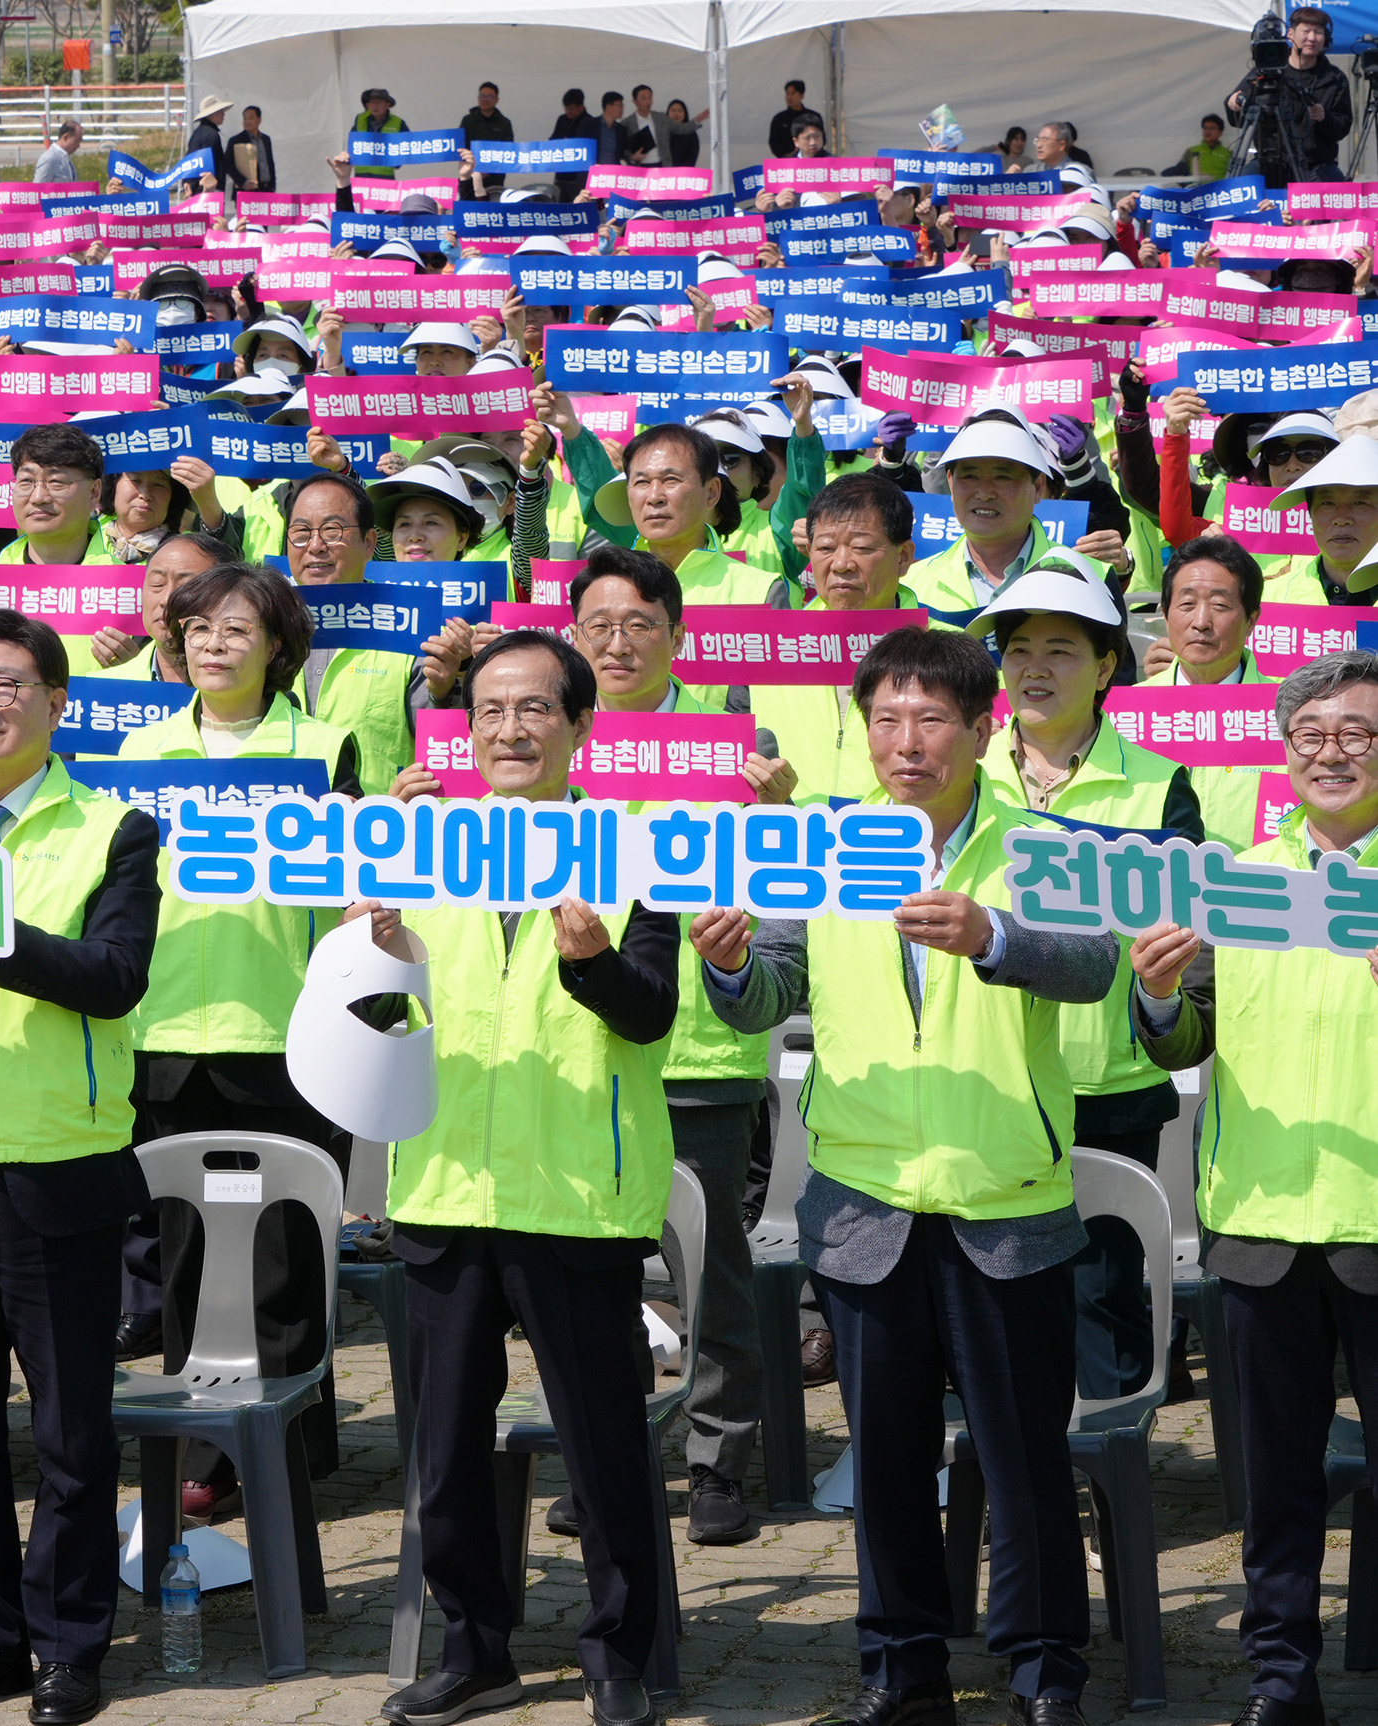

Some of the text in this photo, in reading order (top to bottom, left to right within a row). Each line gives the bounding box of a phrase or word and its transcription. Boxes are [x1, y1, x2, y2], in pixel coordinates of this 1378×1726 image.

[353, 139, 454, 155] 행복한 농촌일손돕기
[480, 148, 586, 164] 행복한 농촌일손돕기
[768, 168, 890, 182] 농업에 희망을! 농촌에 행복을!
[1140, 186, 1257, 213] 행복한 농촌일손돕기
[1291, 194, 1356, 208] 농업에 희망을!
[463, 212, 588, 227] 행복한 농촌일손돕기
[33, 229, 61, 246] 농촌에
[63, 224, 96, 242] 행복을!
[341, 223, 381, 239] 행복한
[628, 227, 762, 247] 농업에 희망을! 농촌에 행복을!
[788, 235, 909, 255] 행복한 농촌일손돕기
[1, 275, 72, 293] 농촌에 행복을!
[259, 272, 330, 288] 농업에 희망을!
[520, 270, 682, 289] 행복한 농촌일손돕기
[334, 289, 508, 309] 농업에 희망을! 농촌에 행복을!
[1036, 283, 1163, 302] 농업에 희망을! 농촌에
[1167, 294, 1300, 326] 농업에 희망을! 농촌에
[45, 312, 142, 333] 농촌일손돕기
[785, 313, 947, 341] 행복한 농촌일손돕기
[563, 348, 769, 374] 행복한 농촌일손돕기
[1, 372, 45, 394] 희망을!
[50, 373, 96, 394] 농촌에
[100, 372, 151, 394] 행복을!
[868, 366, 1082, 407] 농업에 희망을! 행복을!
[1194, 368, 1264, 393] 행복한
[314, 387, 528, 416] 농업에 희망을! 농촌에 행복을!
[212, 436, 249, 460] 복한
[1229, 505, 1280, 533] 농업에
[22, 586, 76, 613] 농촌에
[81, 587, 142, 614] 행복을!
[701, 633, 842, 662] 희망을! 농촌에
[1151, 710, 1216, 742] 농촌에
[590, 739, 743, 775] 농촌에 행복을!
[178, 800, 925, 910] 농업인에게 희망을
[1013, 839, 1291, 941] 전하는
[233, 1184, 257, 1193] 문승우
